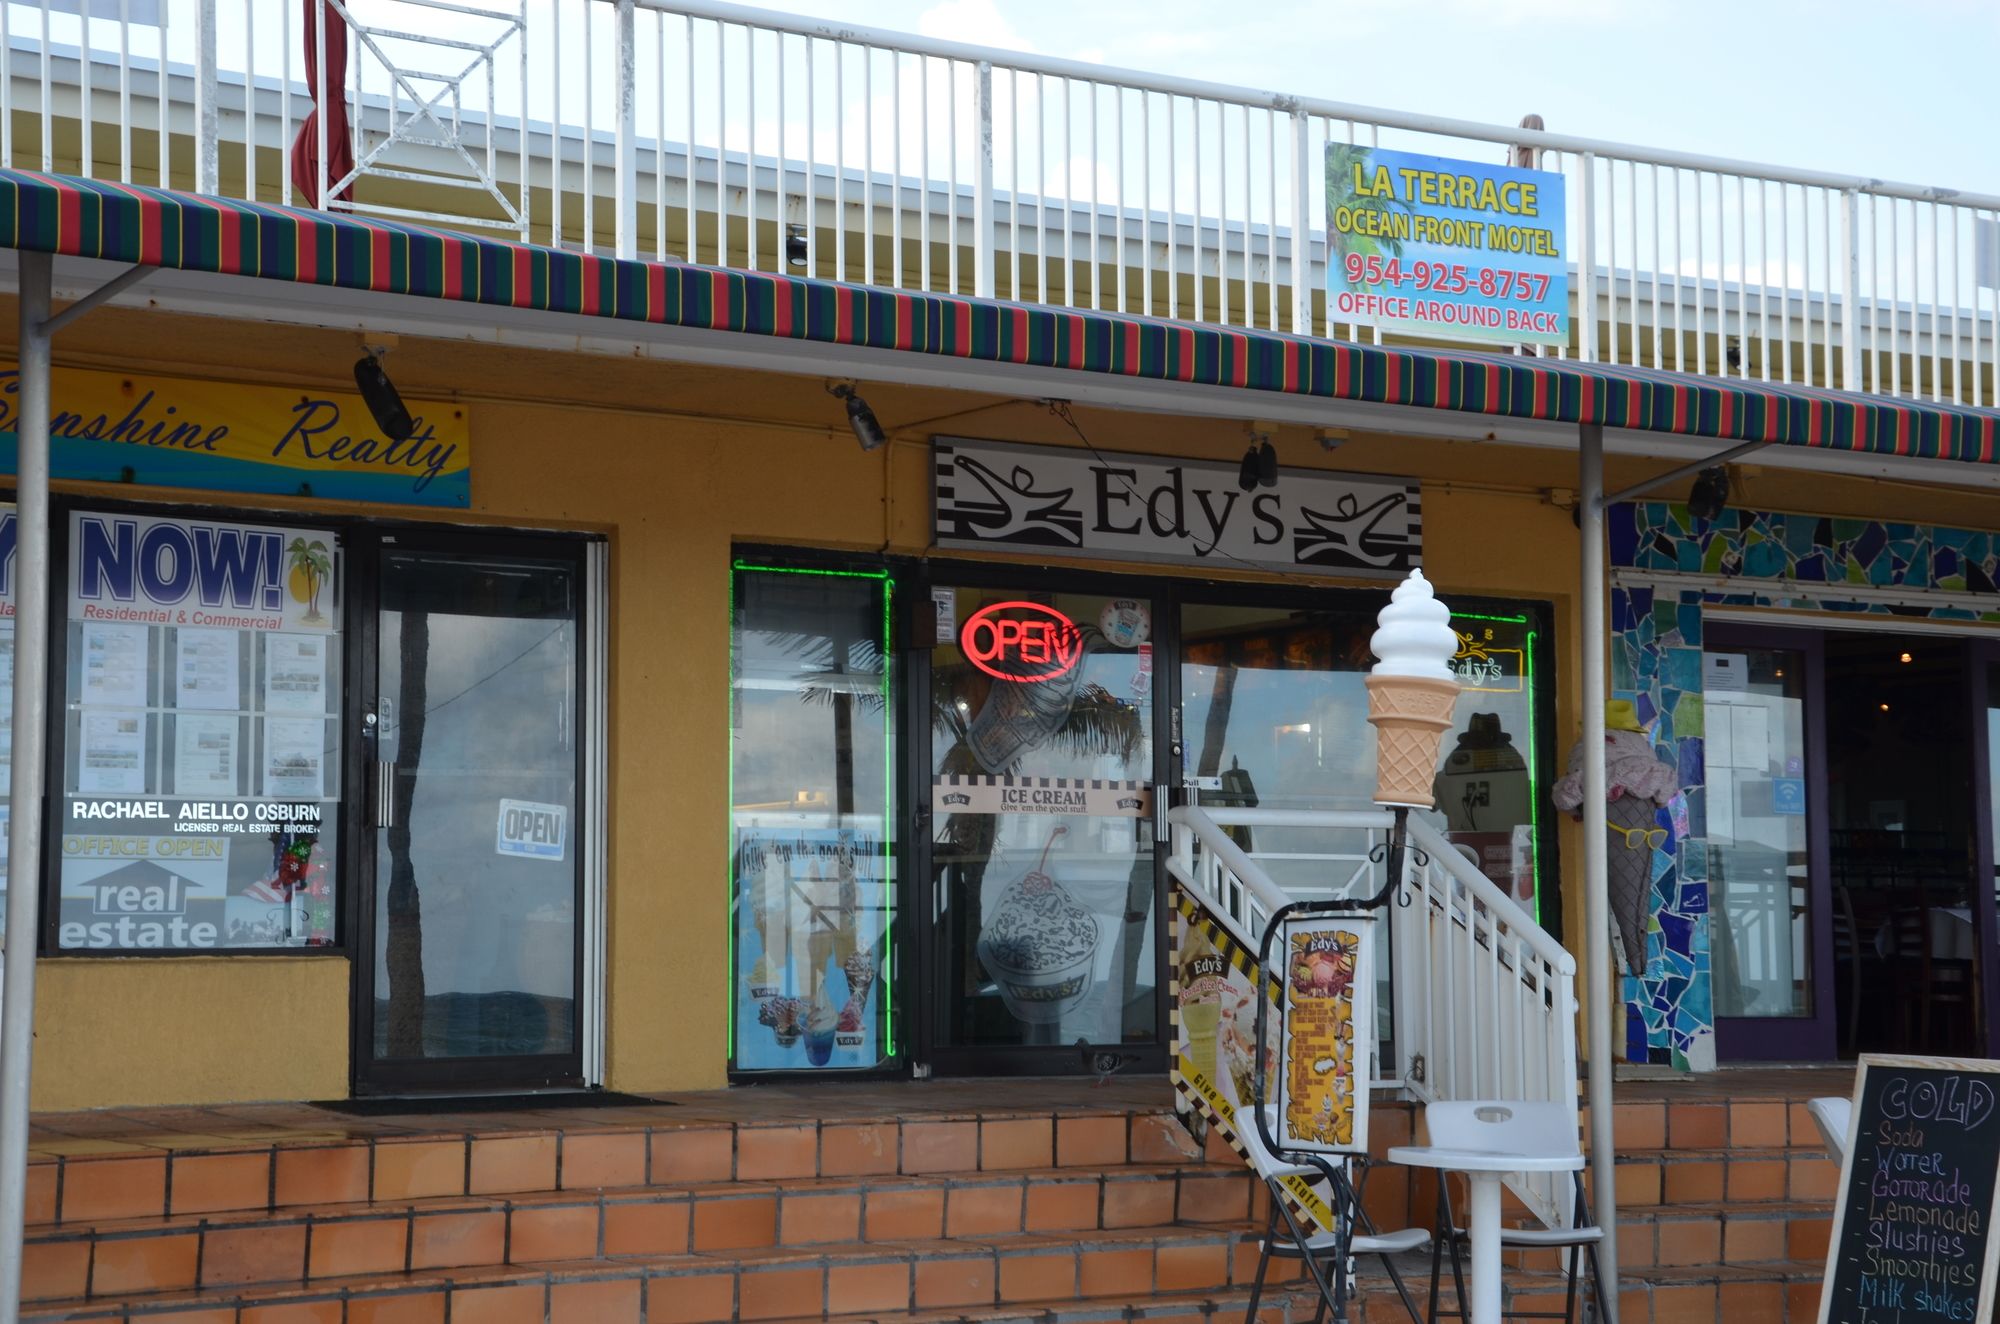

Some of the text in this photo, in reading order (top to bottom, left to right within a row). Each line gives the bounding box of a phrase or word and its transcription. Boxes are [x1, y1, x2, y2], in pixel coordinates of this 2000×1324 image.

[1353, 162, 1539, 218] LA TERRACE
[1335, 206, 1559, 257] OCEAN FRONT MOTEL
[1345, 252, 1551, 304] 954-925-8757
[1337, 291, 1560, 334] OFFICE AROUND BACK
[272, 400, 457, 493] Realty
[78, 516, 285, 612] NOW!
[83, 604, 283, 630] Residential & Commercial
[969, 617, 1071, 669] OPEN
[73, 801, 321, 822] RACHAEL AIELLO OSBURN
[1000, 803, 1018, 812] Give
[1035, 804, 1048, 812] the
[1049, 804, 1068, 814] good
[1001, 789, 1087, 806] ICE CREAM
[174, 822, 219, 833] LICENSED
[222, 823, 246, 833] REAL
[249, 823, 281, 834] ESTATE
[504, 808, 562, 845] OPEN
[62, 834, 225, 857] OFFICE OPEN
[99, 875, 178, 912] real
[60, 916, 218, 948] estate
[1310, 937, 1339, 952] Edy's
[1193, 957, 1223, 975] Edy's
[1193, 1072, 1218, 1101] Give
[1879, 1120, 1925, 1149] Soda
[1866, 1220, 1965, 1258] Slushies
